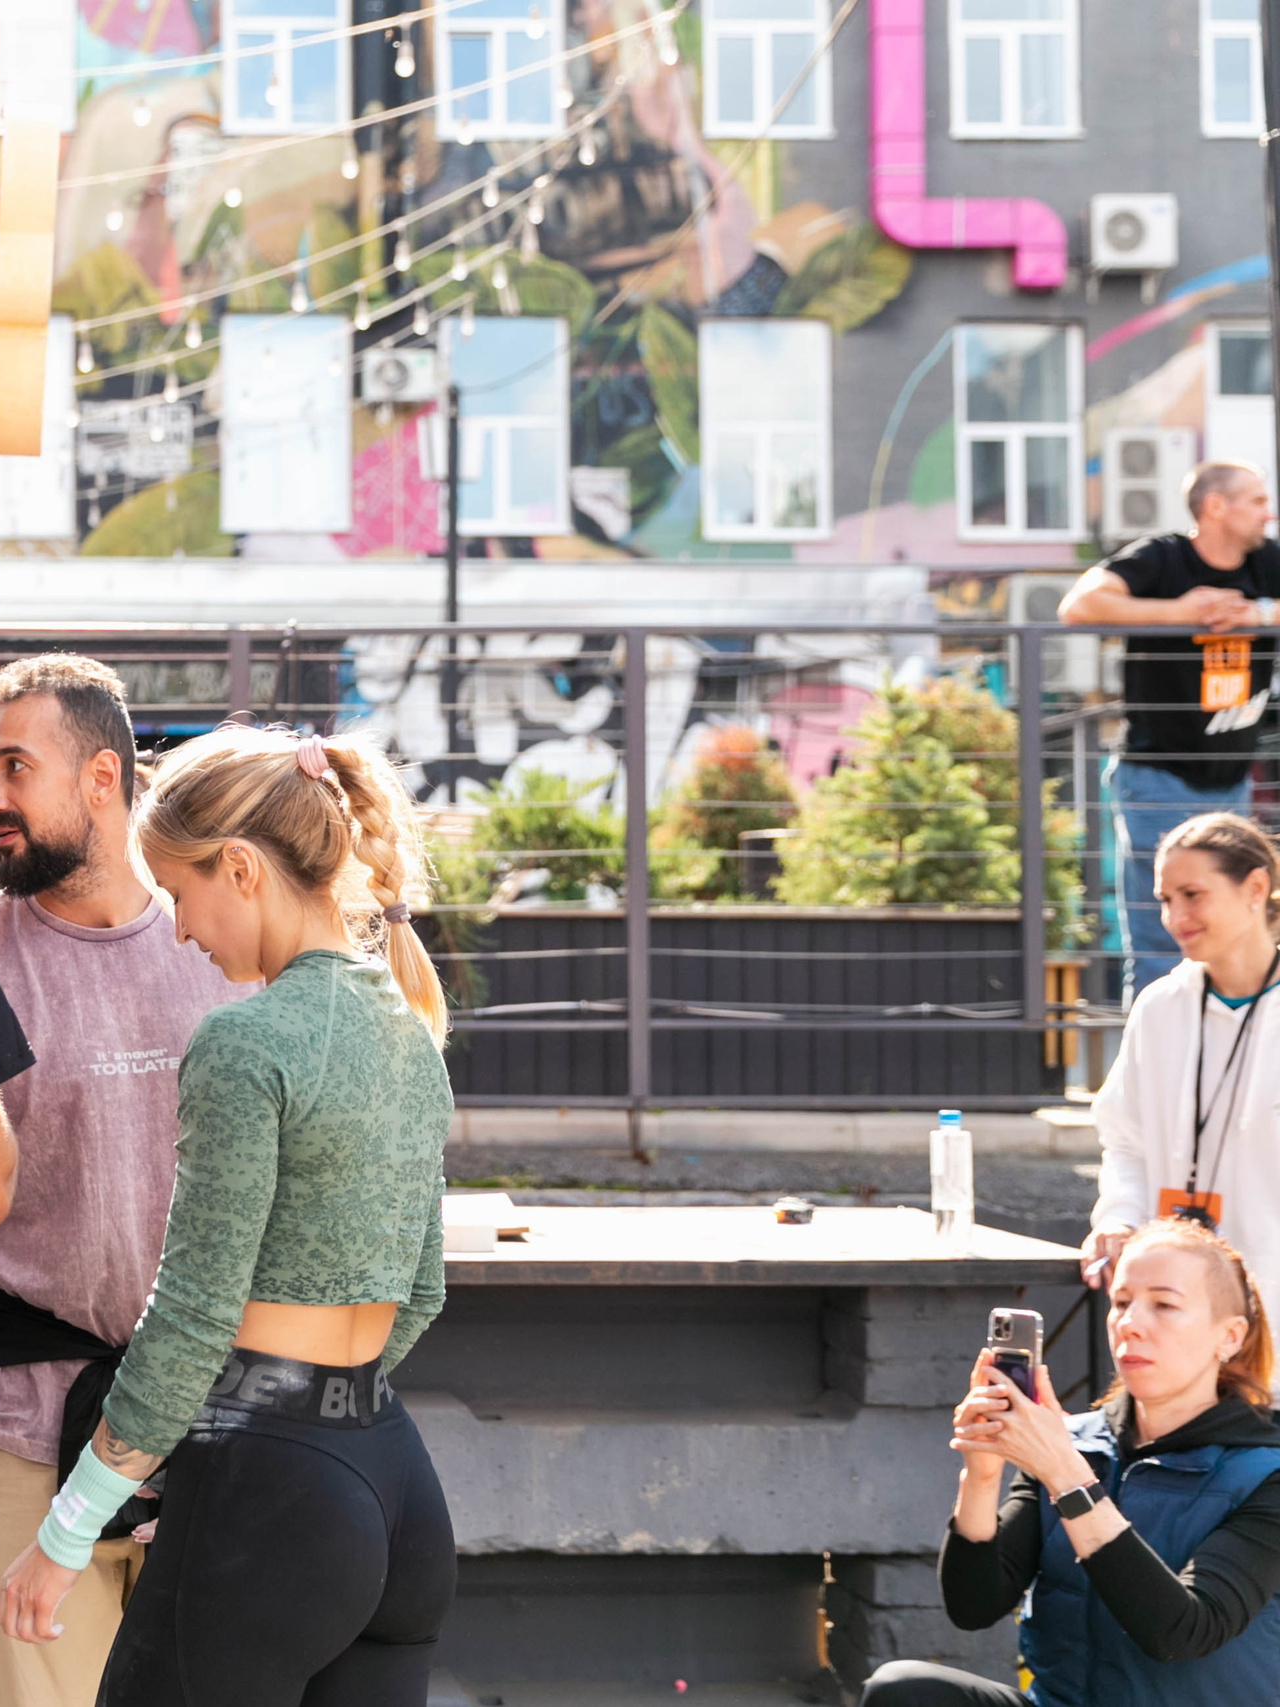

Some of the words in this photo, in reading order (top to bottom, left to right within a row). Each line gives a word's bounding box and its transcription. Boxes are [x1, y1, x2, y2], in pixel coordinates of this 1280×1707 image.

[123, 1048, 168, 1060] never
[89, 1062, 129, 1076] TOO
[131, 1057, 181, 1074] LATE
